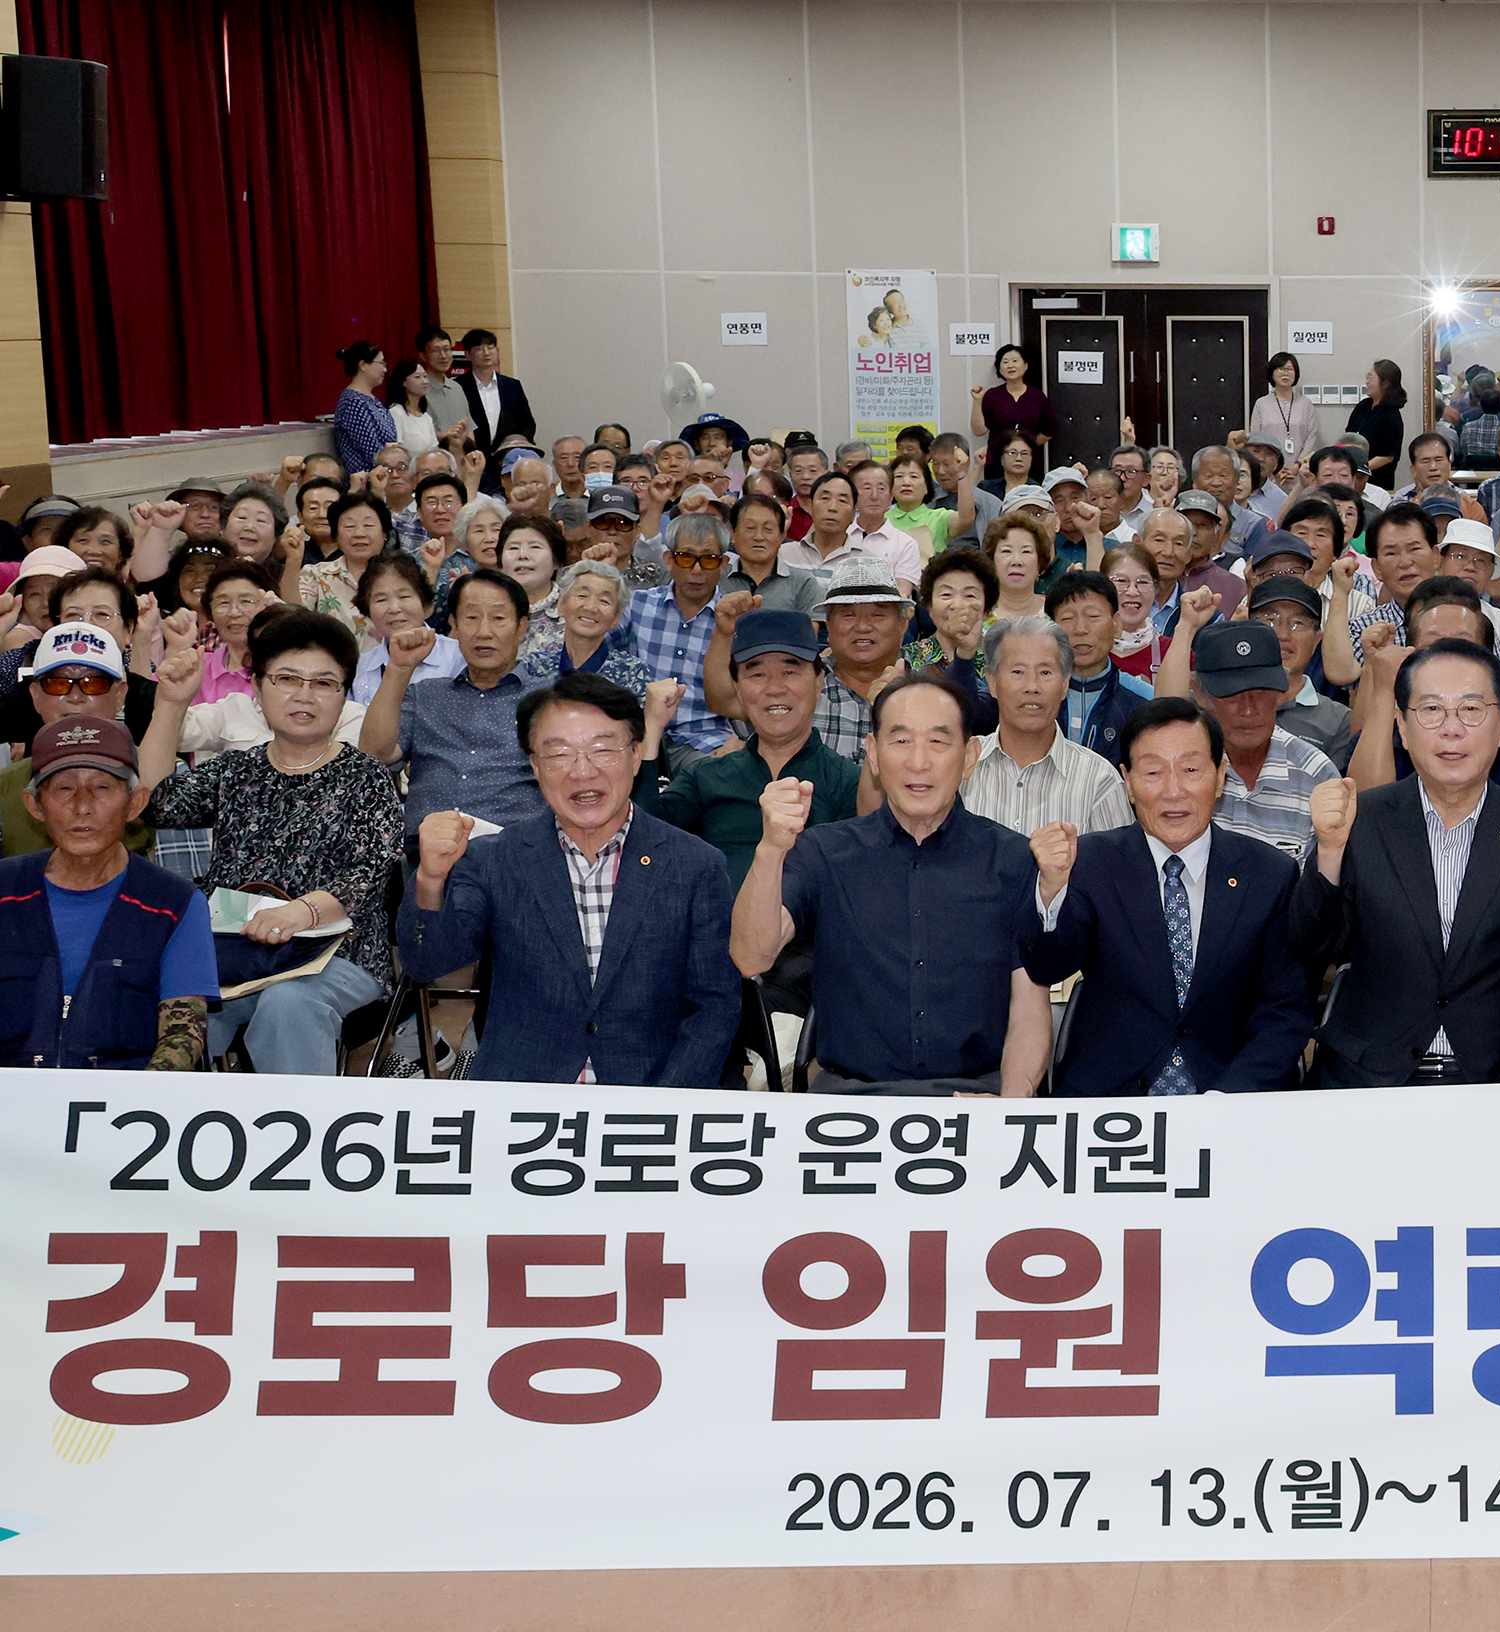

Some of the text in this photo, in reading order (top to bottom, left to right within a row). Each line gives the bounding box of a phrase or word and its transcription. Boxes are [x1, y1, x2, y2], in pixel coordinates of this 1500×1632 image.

[726, 323, 762, 335] 연풍면
[955, 333, 990, 345] 불정면
[1293, 331, 1328, 343] 칠성면
[856, 352, 931, 373] 노인취업
[1063, 361, 1098, 372] 불정면
[856, 376, 933, 386] (경비/미화/주차관리 등)
[856, 387, 932, 396] 일자리를 찾아드립니다
[52, 630, 106, 650] Knicks
[65, 1101, 1211, 1198] 「2026년 경로당 운영 지원」
[45, 1230, 687, 1425] 경로당
[762, 1227, 1162, 1422] 임원
[785, 1471, 975, 1533] 2026.
[1008, 1470, 1111, 1531] 07.
